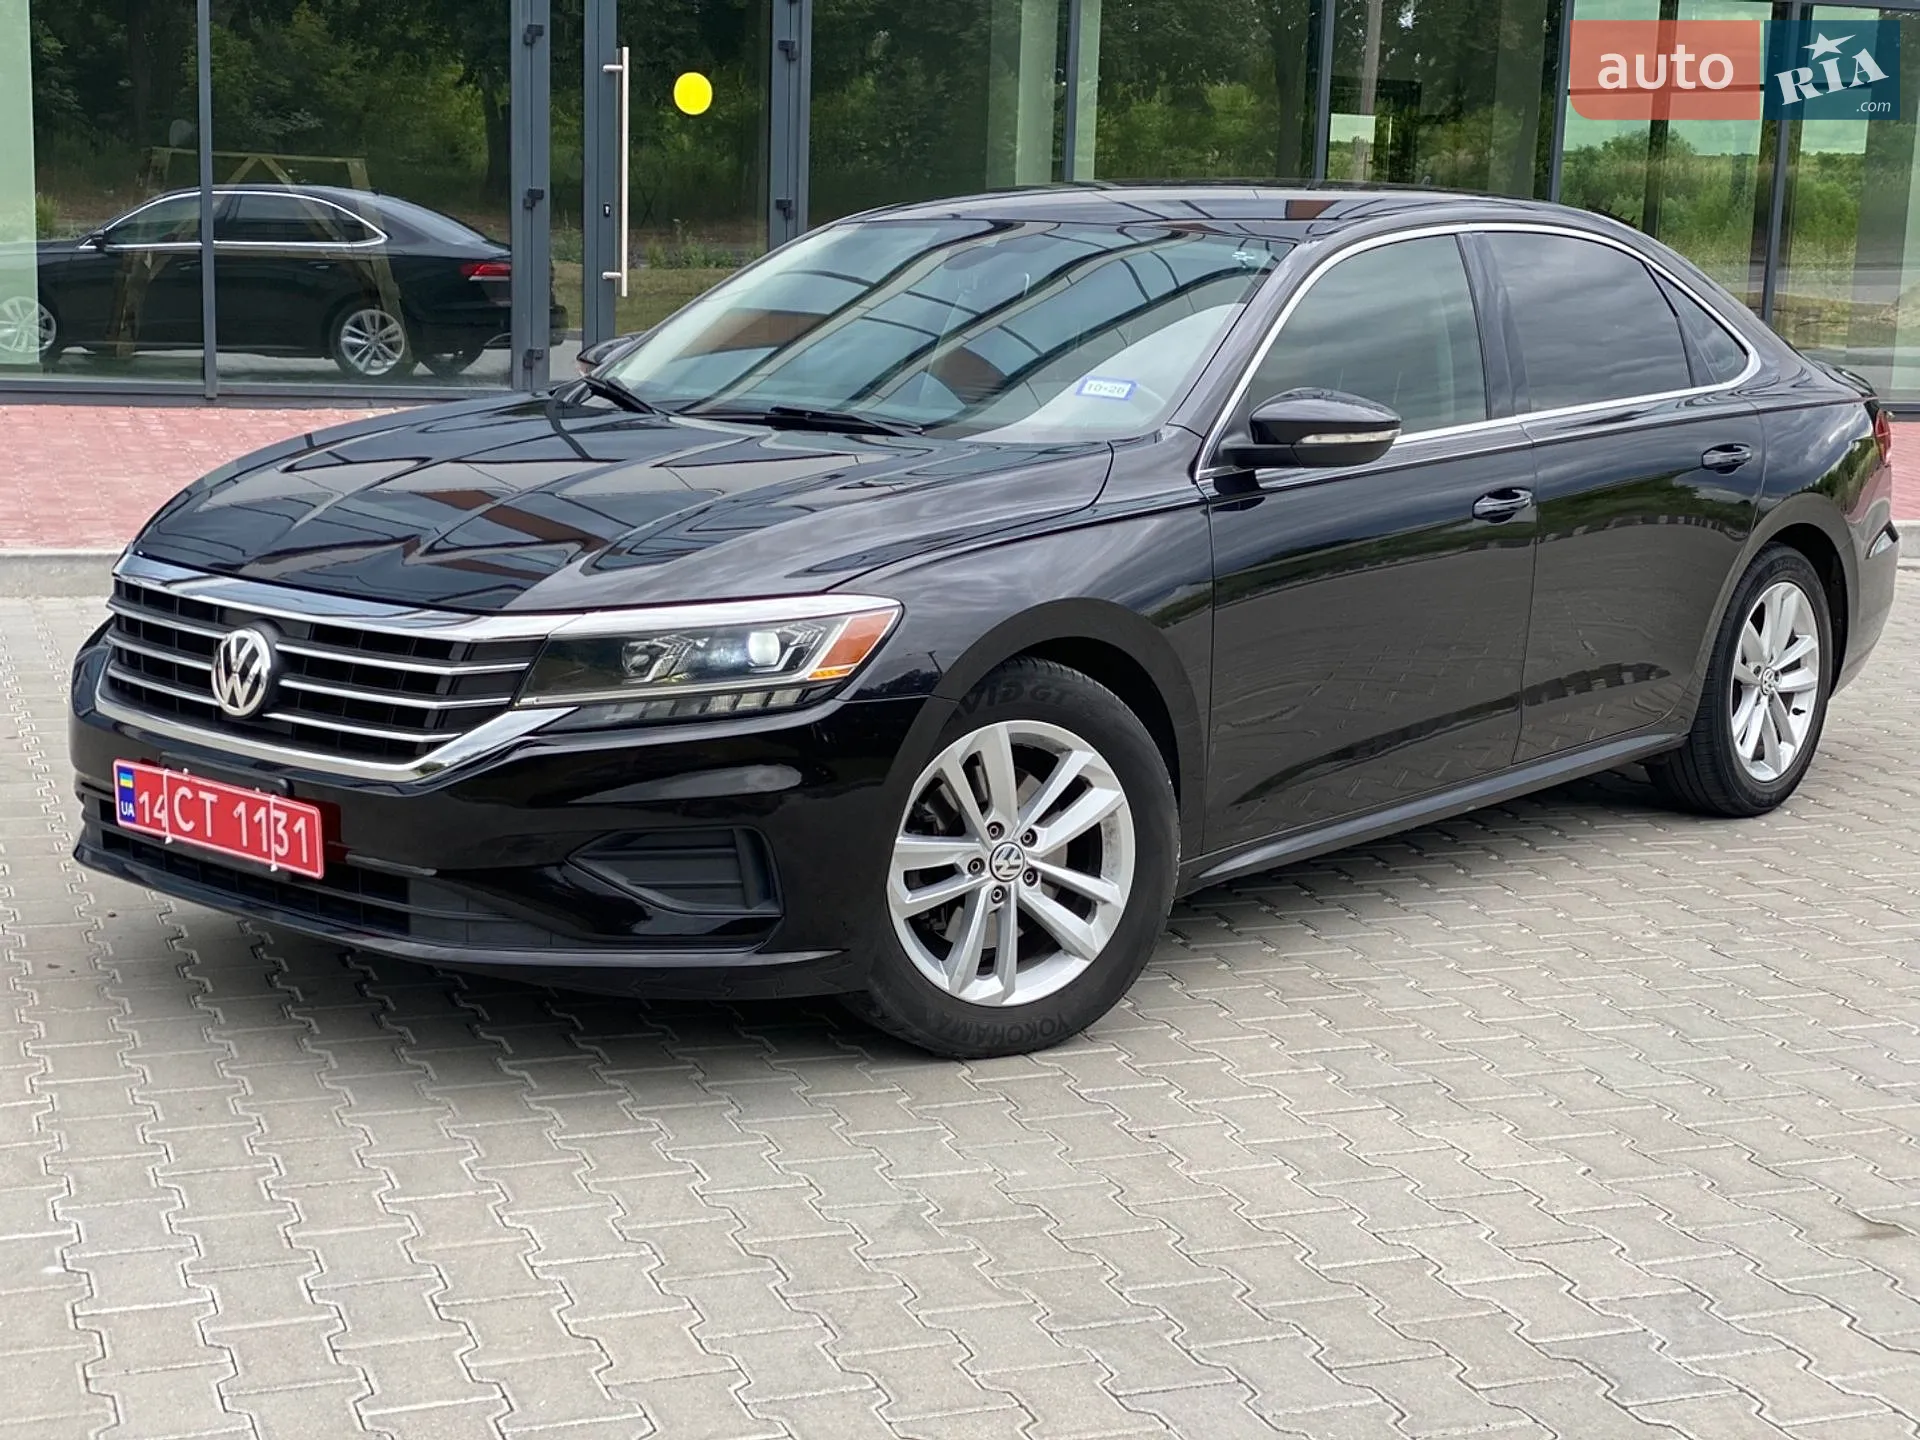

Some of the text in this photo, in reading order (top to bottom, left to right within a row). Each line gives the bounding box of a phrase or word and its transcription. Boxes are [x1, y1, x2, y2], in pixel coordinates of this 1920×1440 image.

[121, 802, 135, 817] UA
[232, 801, 308, 864] 1131
[938, 1012, 1071, 1046] YOKOHAMA
